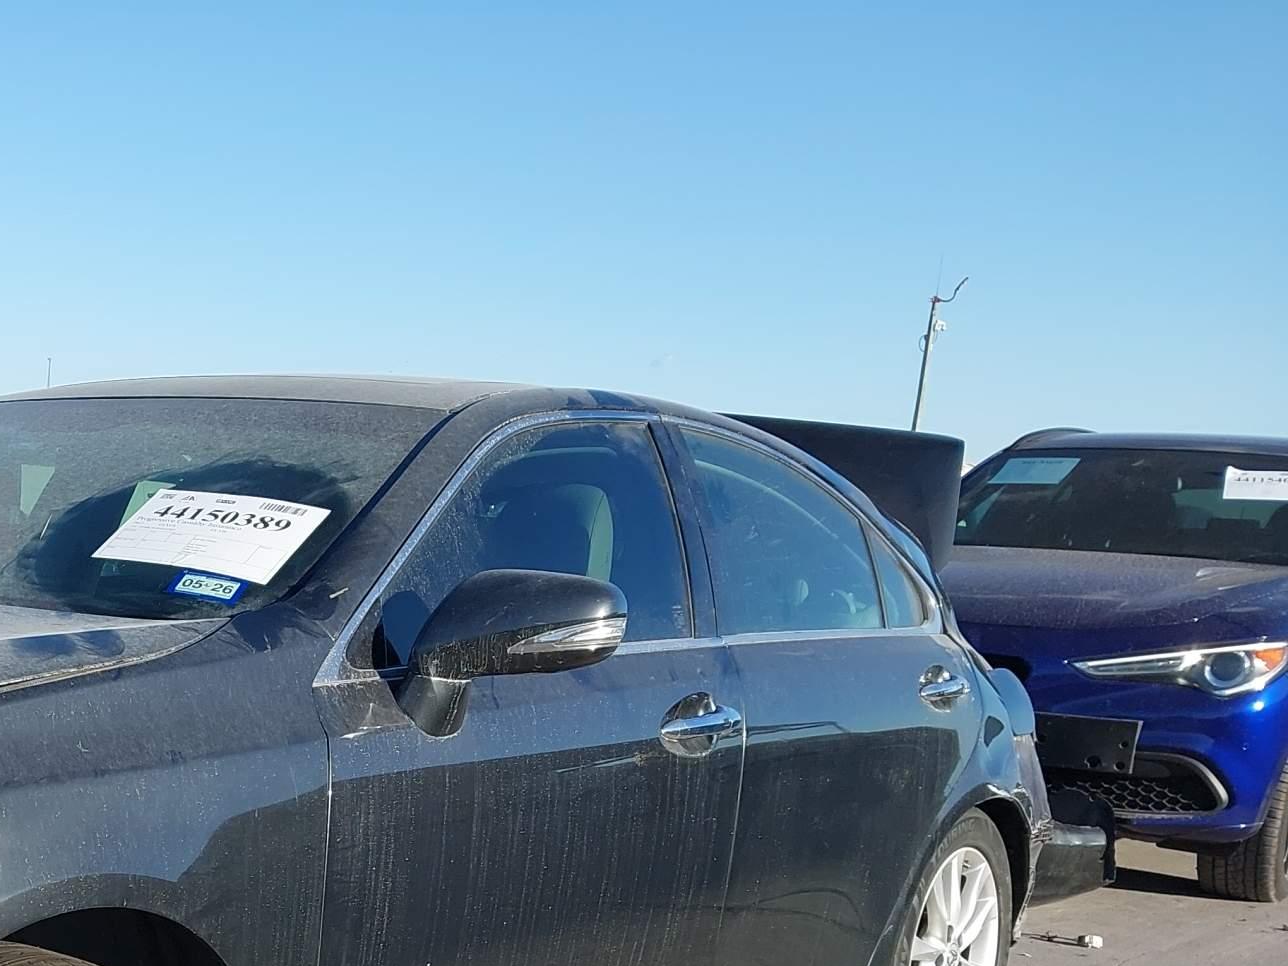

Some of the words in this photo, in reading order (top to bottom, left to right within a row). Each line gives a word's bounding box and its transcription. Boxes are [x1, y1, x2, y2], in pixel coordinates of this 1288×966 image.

[154, 505, 292, 531] 44150389
[182, 579, 205, 589] 05
[211, 582, 235, 594] 26
